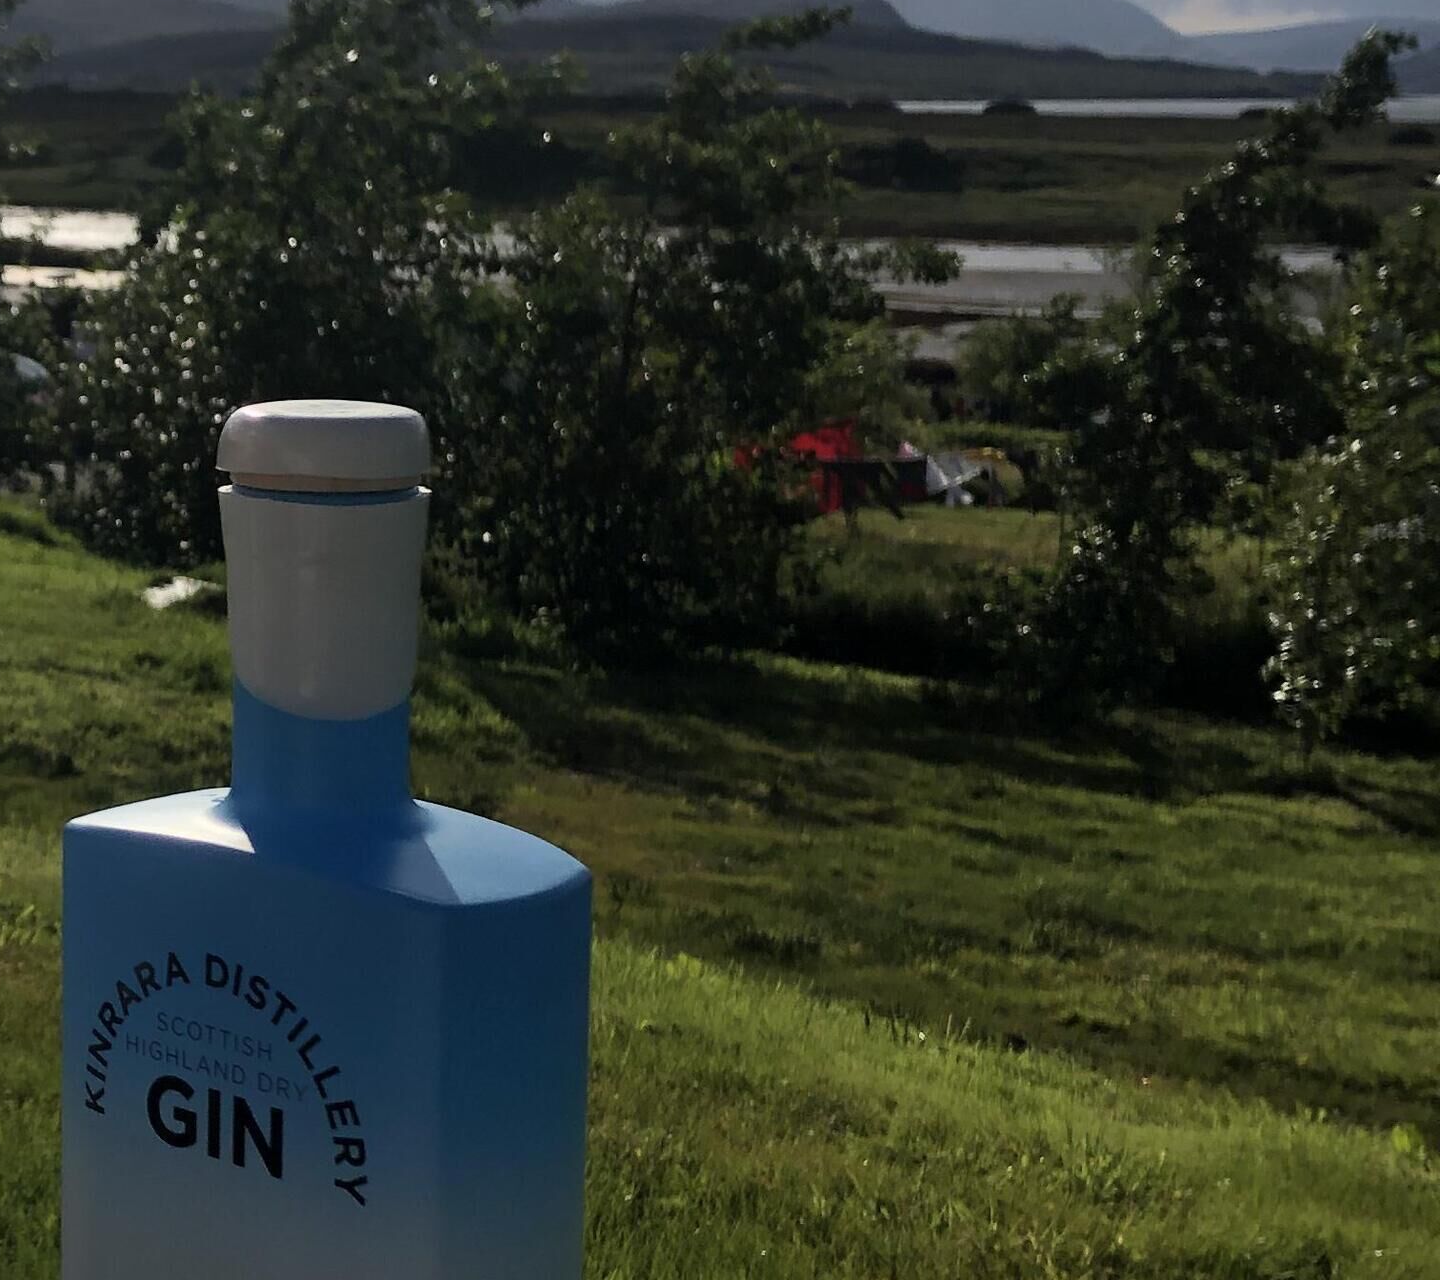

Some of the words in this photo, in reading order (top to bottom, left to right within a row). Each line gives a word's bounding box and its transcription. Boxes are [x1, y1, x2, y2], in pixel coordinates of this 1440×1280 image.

[85, 952, 190, 1114] KINRARA
[205, 953, 368, 1207] DISTILLERY
[126, 1032, 246, 1085] HIGHLAND
[257, 1072, 309, 1102] DRY
[157, 1011, 273, 1062] SCOTTISH
[146, 1075, 284, 1179] GIN
